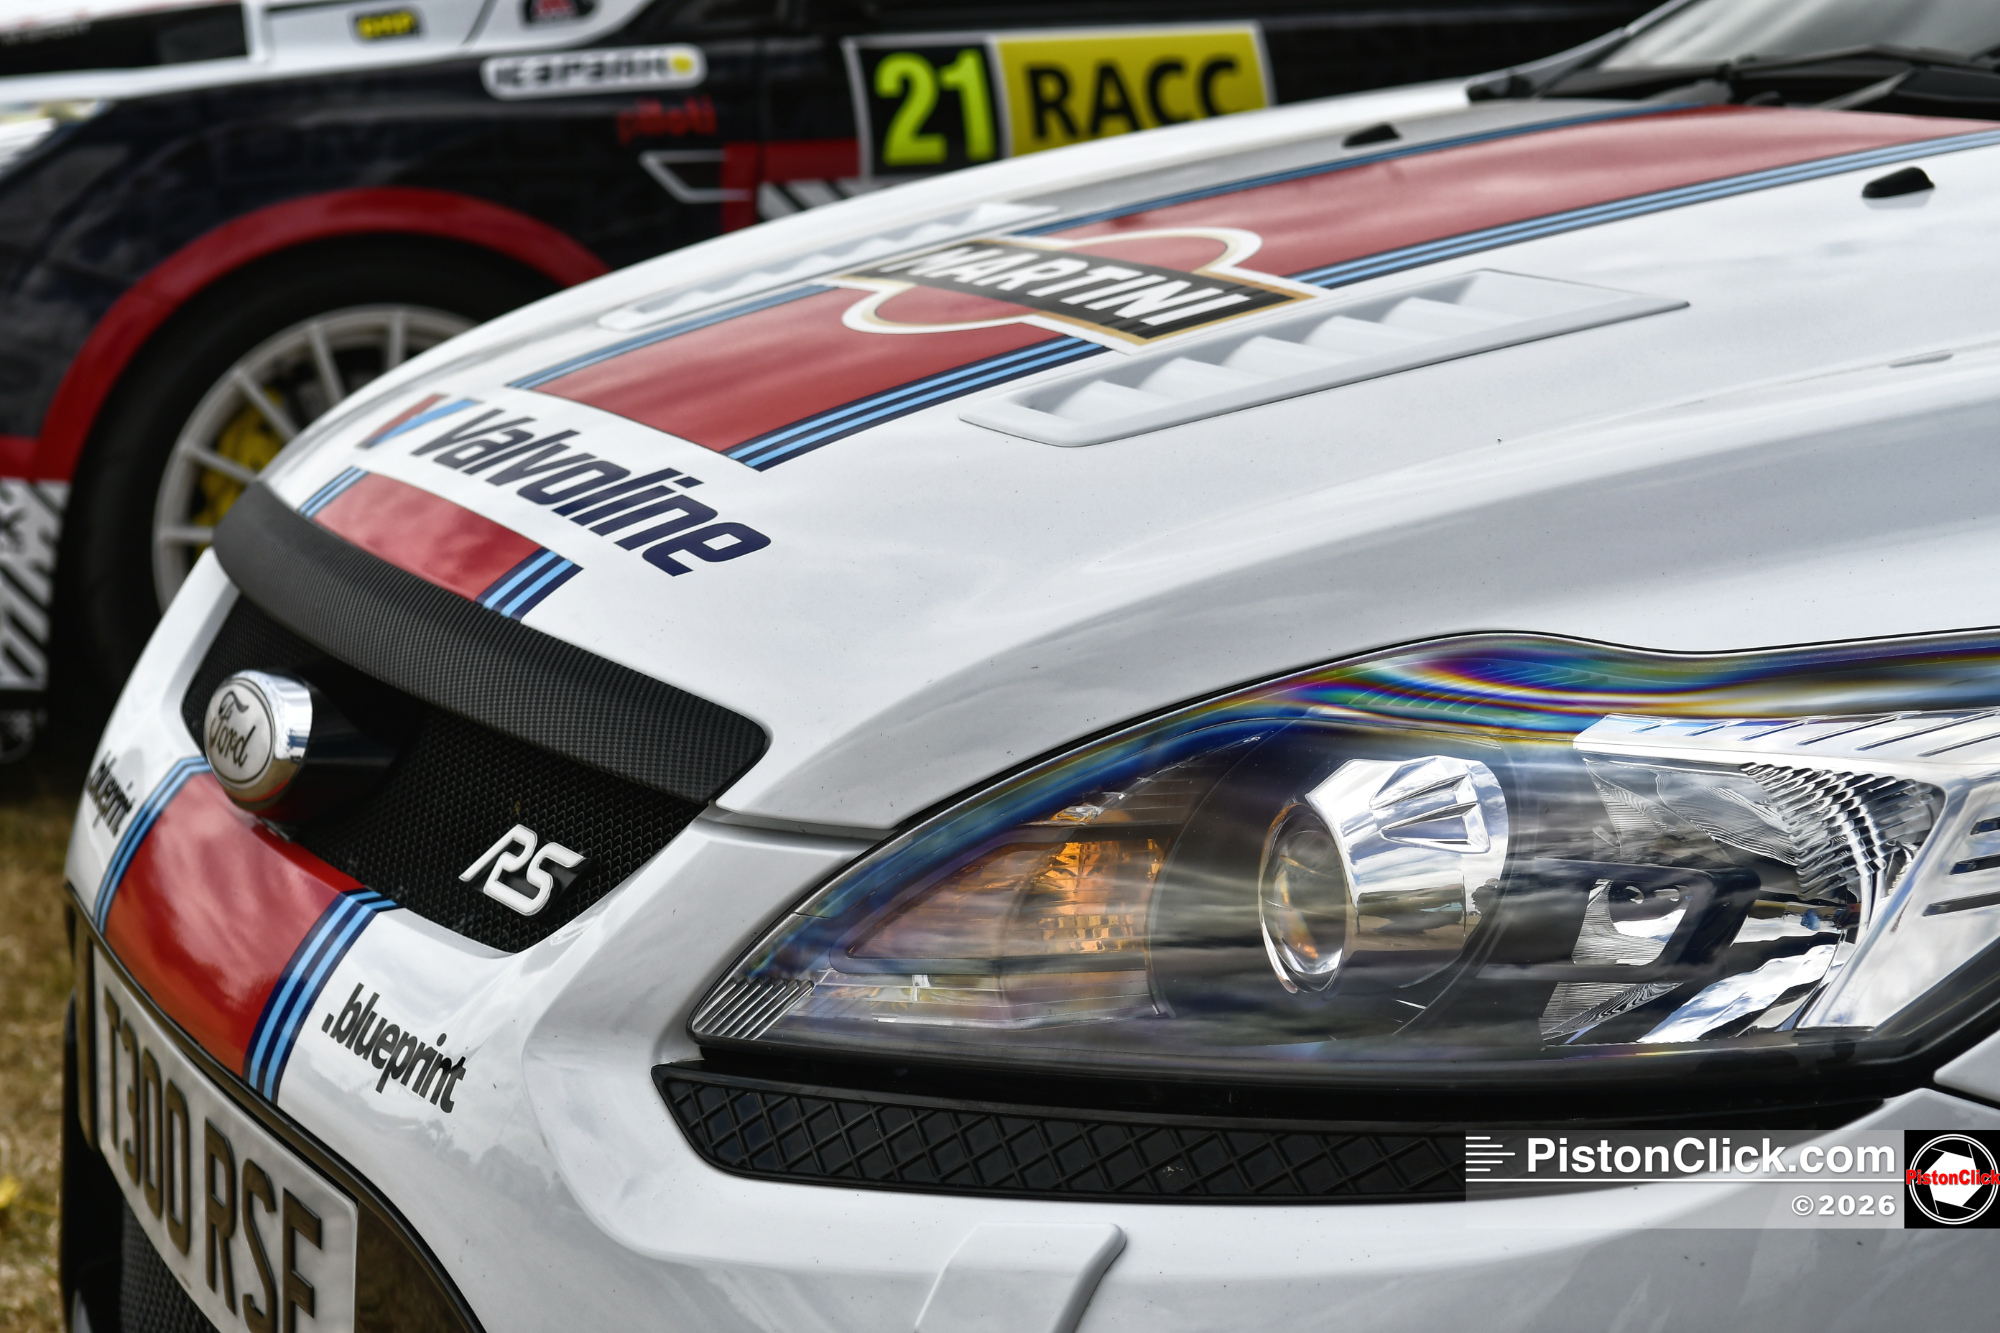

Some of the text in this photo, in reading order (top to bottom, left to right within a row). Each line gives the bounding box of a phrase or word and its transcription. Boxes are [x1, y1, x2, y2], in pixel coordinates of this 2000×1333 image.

[873, 47, 996, 166] 21
[1023, 54, 1241, 141] RACC
[879, 245, 1252, 327] MARTINI
[408, 407, 772, 578] Valvoline
[209, 690, 255, 769] Ford
[458, 823, 587, 917] RS
[320, 982, 467, 1114] .blueprint
